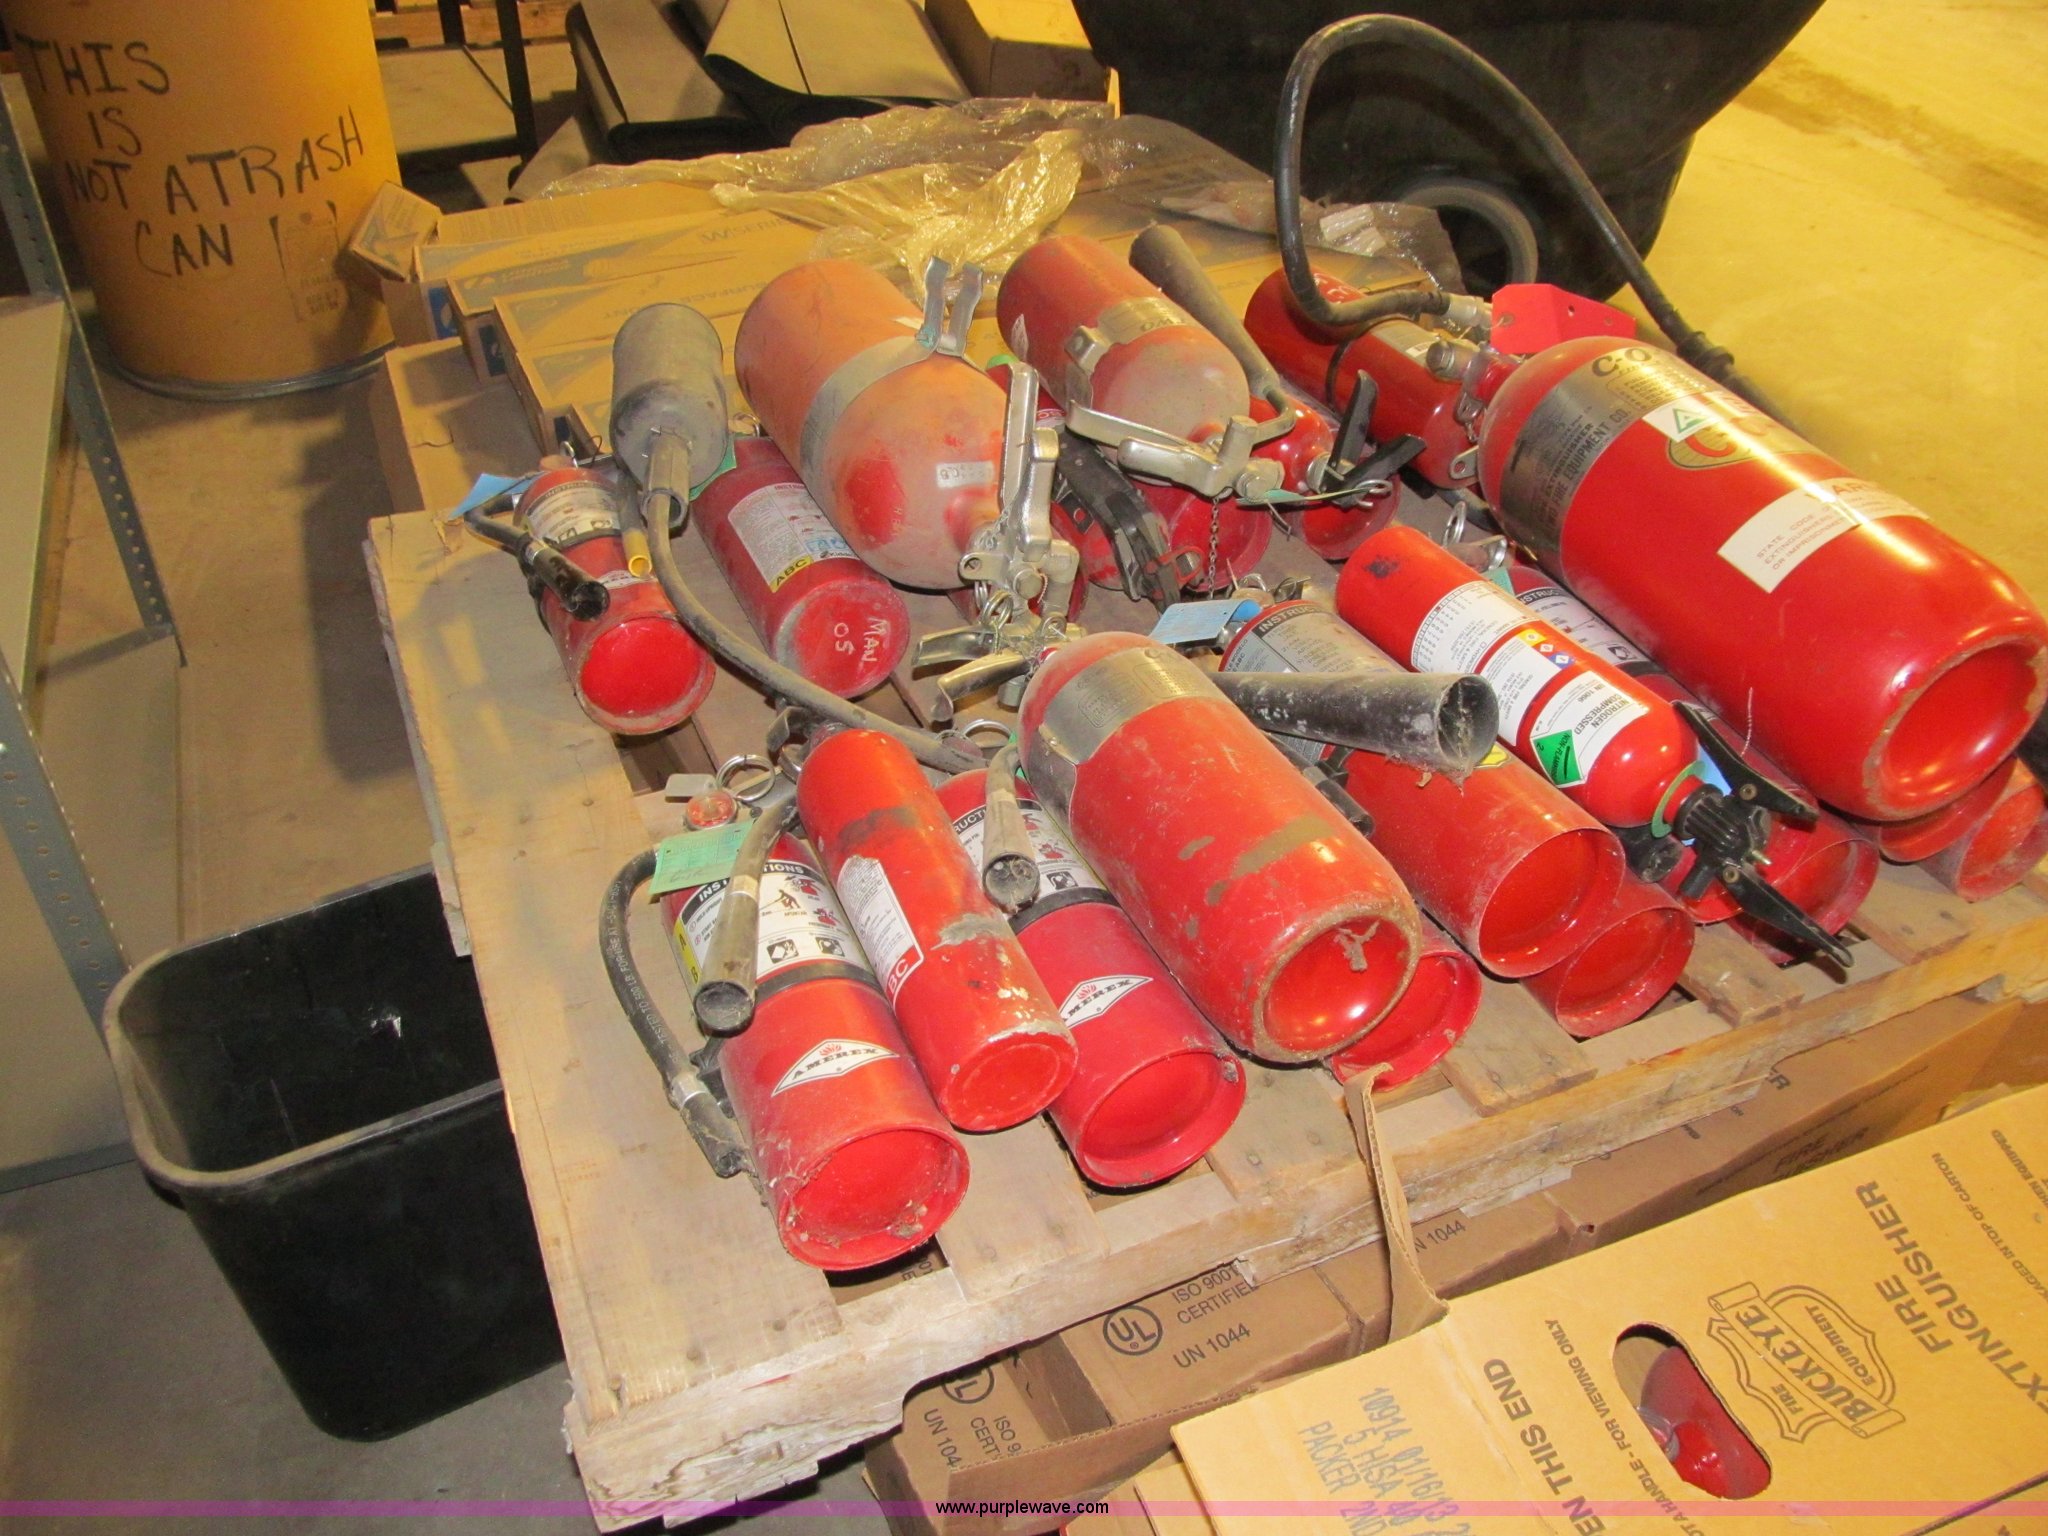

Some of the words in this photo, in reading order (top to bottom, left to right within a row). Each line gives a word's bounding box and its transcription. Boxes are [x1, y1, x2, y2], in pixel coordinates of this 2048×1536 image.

[14, 32, 169, 95] THIS
[88, 107, 142, 156] IS
[67, 158, 131, 209] NOT
[135, 220, 233, 278] CAN
[1565, 421, 1610, 480] EQUIPMENT
[776, 558, 807, 587] ABC
[1574, 693, 1623, 735] COMPRESSED
[1591, 697, 1631, 729] NITROGEN
[793, 1048, 879, 1080] AMEREX
[1932, 1152, 1971, 1202] CARTON
[1427, 1220, 1466, 1244] 1044
[1966, 1202, 1984, 1221] OF
[1981, 1221, 2003, 1247] TOP
[2000, 1245, 2015, 1260] IN
[1172, 1283, 1201, 1304] ISO
[1875, 1274, 1953, 1354] FIRE
[1173, 1344, 1206, 1368] UN
[1206, 1322, 1250, 1352] 1044
[1545, 1318, 1575, 1356] ONLY
[1805, 1305, 1876, 1386] EQUIPMENT
[1735, 1304, 1878, 1422] BUCKEYE
[1483, 1358, 1533, 1421] END
[1568, 1356, 1611, 1419] VIEWING
[1771, 1383, 1804, 1415] FIRE
[924, 1408, 948, 1436] UN
[937, 1437, 962, 1468] 104
[994, 1415, 1016, 1441] ISO
[1605, 1418, 1632, 1451] FOR
[1298, 1420, 1362, 1494] PACKER
[1520, 1423, 1573, 1495] THIS
[1629, 1458, 1678, 1514] HANDLE
[1562, 1495, 1606, 1536] EN
